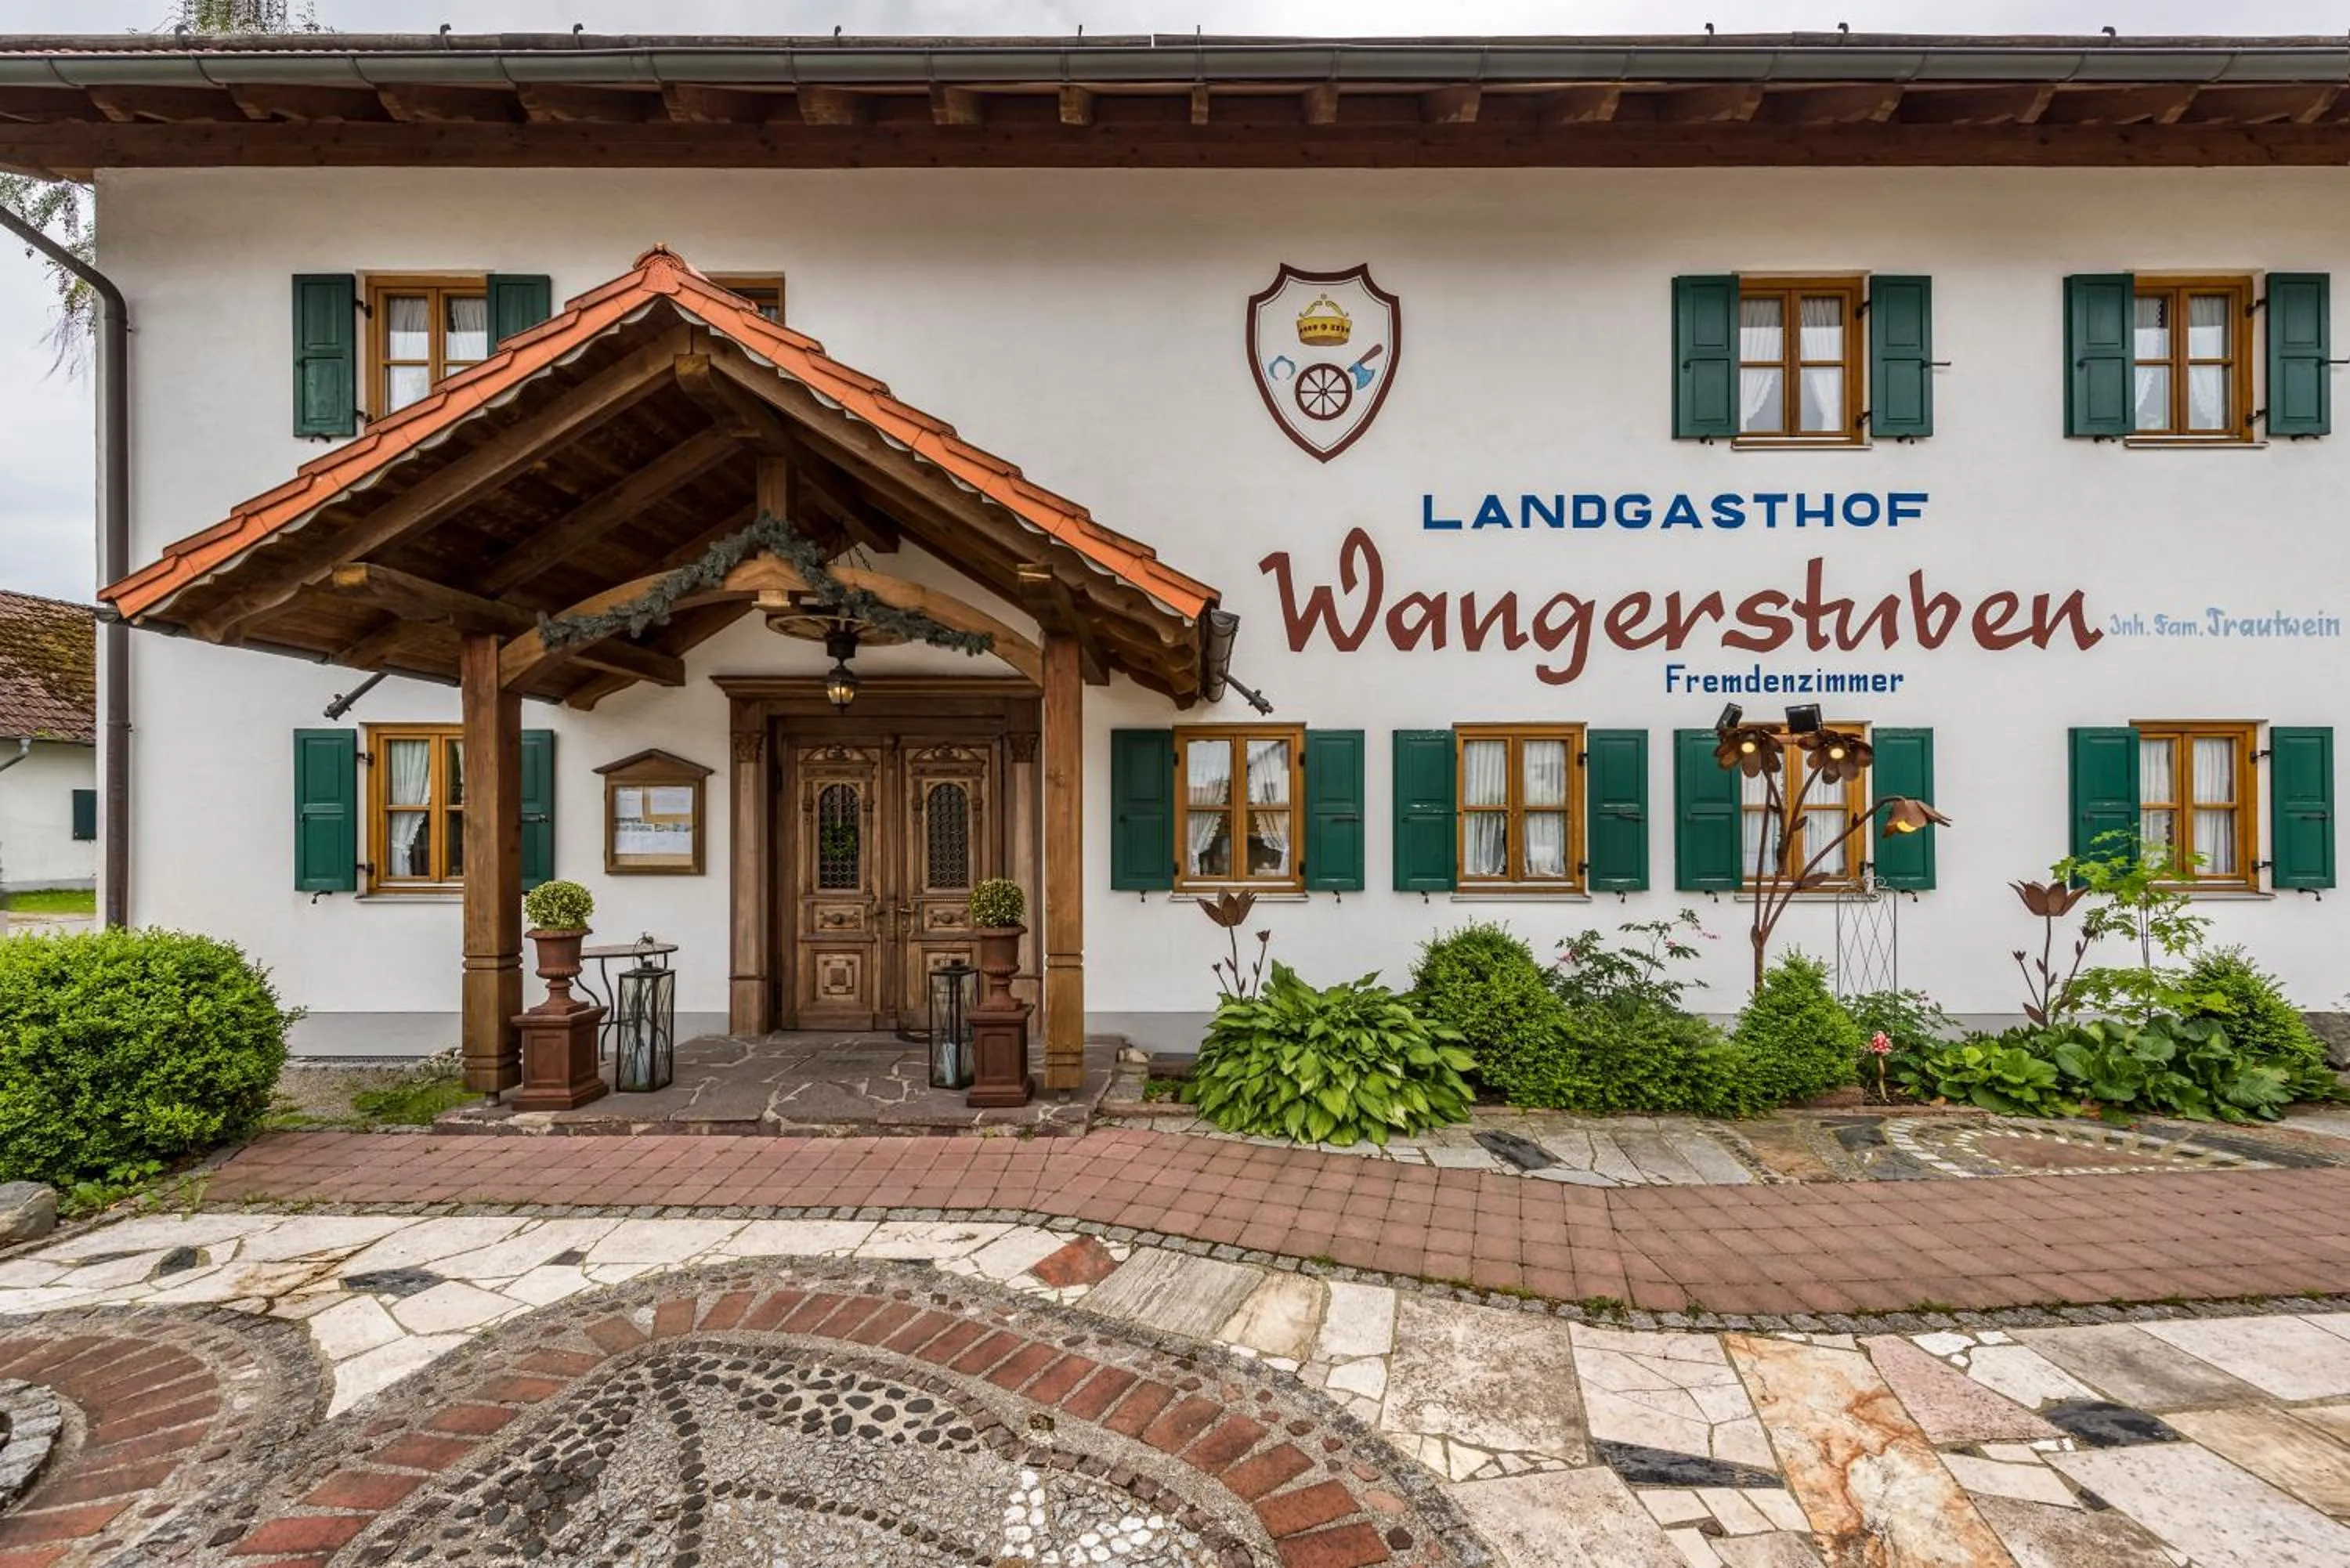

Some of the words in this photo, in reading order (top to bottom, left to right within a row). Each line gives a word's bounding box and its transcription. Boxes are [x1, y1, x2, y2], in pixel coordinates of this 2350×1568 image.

[1423, 492, 1929, 530] LANDGASTHOF
[1258, 526, 2104, 685] Wangerstuben
[2205, 607, 2341, 637] Trautwein
[1665, 663, 1904, 694] Fremdenzimmer
